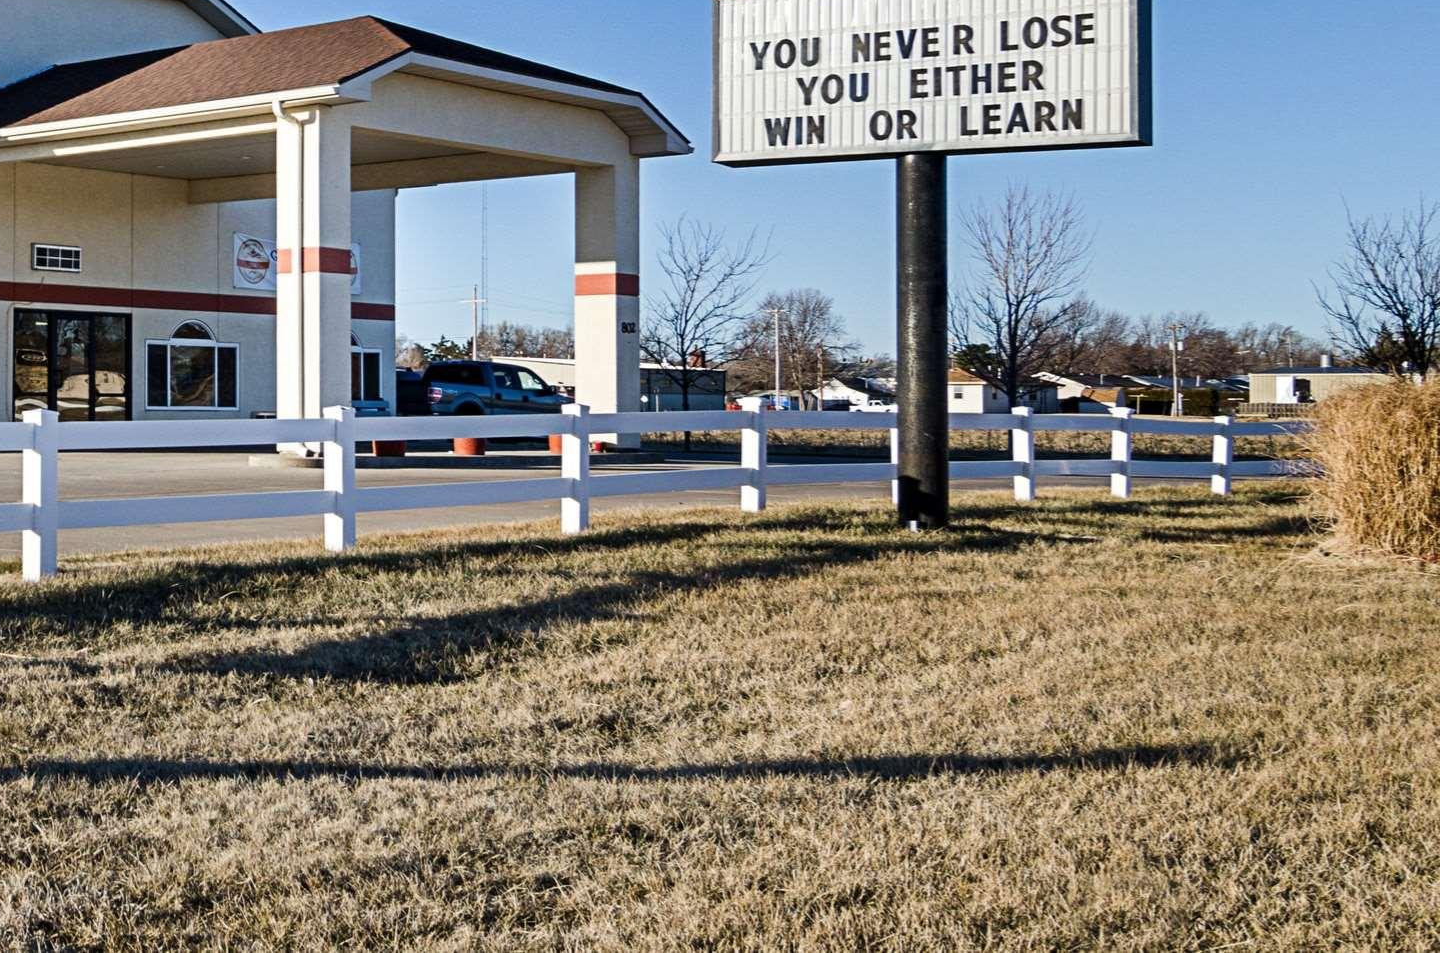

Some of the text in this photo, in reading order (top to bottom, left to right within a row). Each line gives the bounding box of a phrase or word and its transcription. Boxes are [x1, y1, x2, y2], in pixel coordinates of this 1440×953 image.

[749, 13, 1095, 70] YOU NEVER LOSE
[796, 60, 1045, 106] YOU EITHER
[764, 99, 1083, 147] WIN OR LEARN
